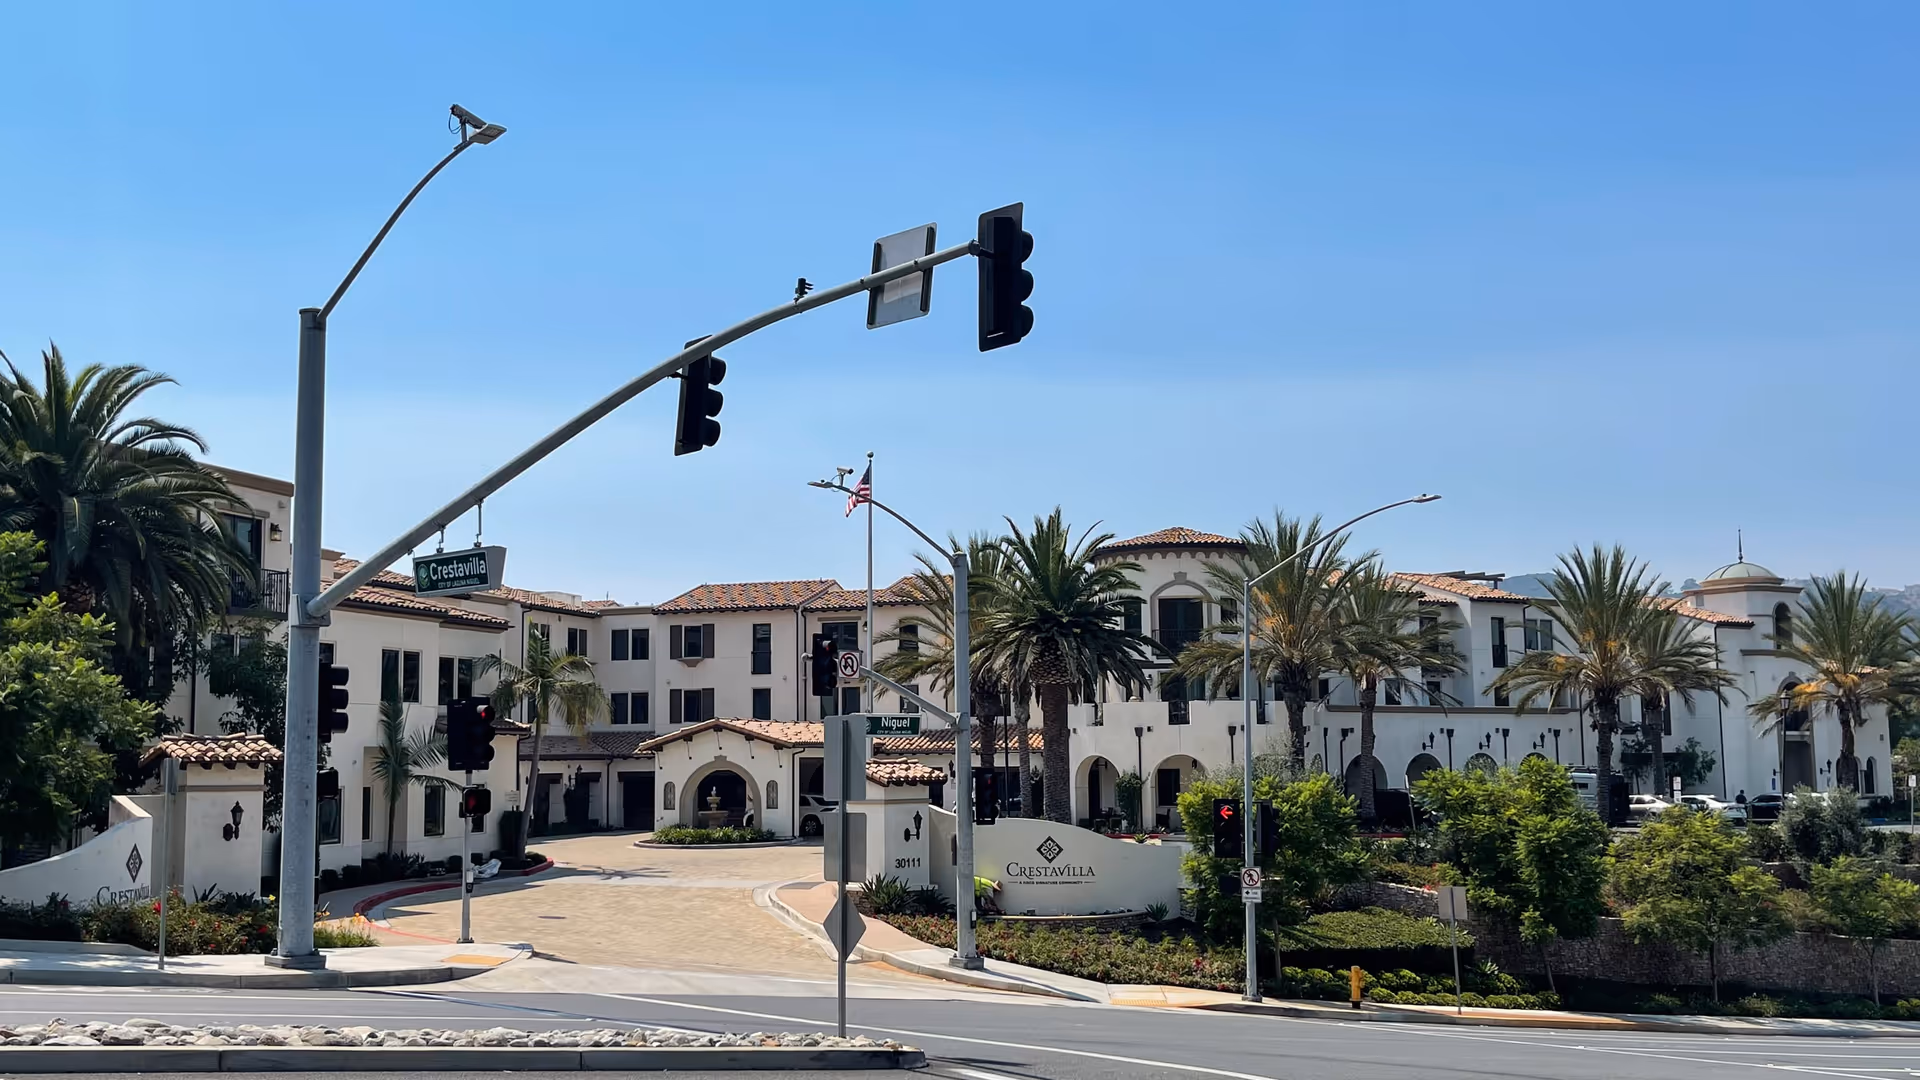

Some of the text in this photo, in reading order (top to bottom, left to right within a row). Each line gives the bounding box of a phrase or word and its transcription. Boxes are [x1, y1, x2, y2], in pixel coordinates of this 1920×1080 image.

[429, 557, 487, 580] Crestavilla
[881, 717, 910, 730] Niguel
[895, 857, 921, 869] 30111
[1006, 862, 1096, 880] CRESTAVILLA
